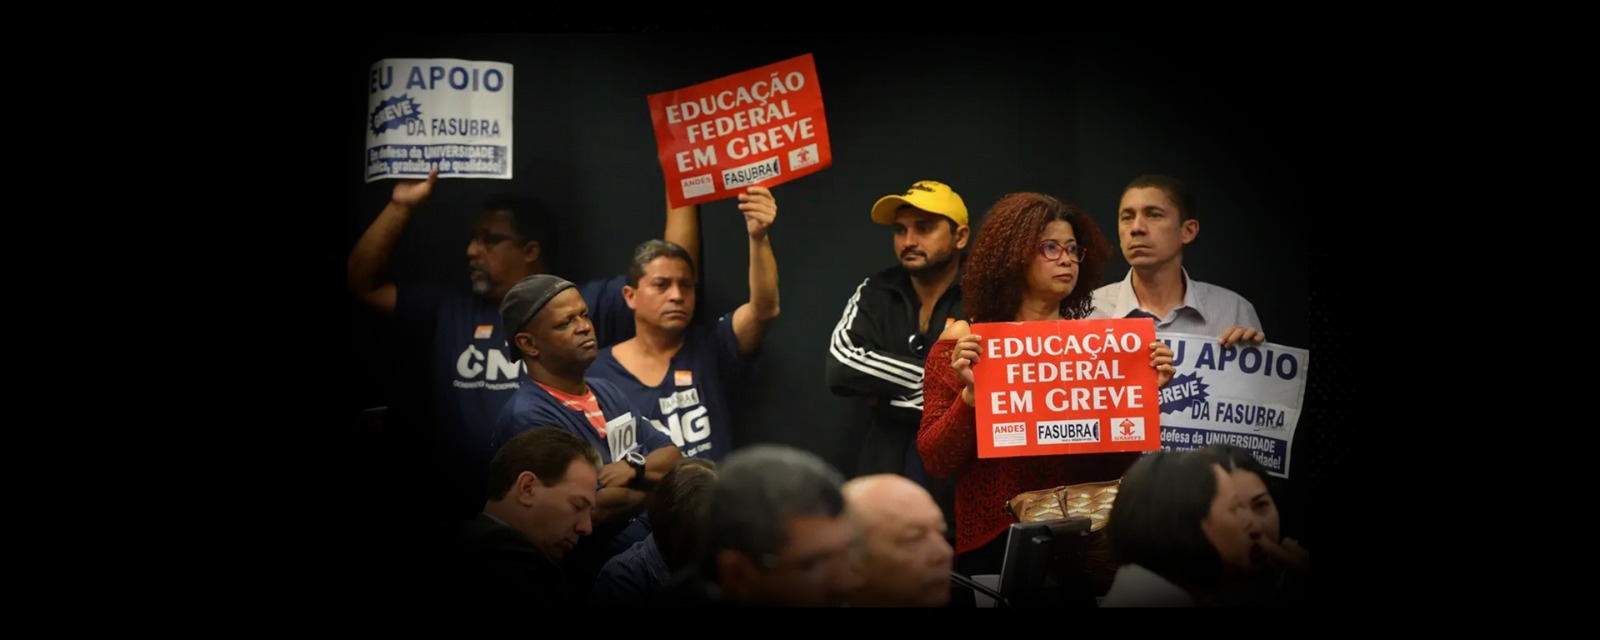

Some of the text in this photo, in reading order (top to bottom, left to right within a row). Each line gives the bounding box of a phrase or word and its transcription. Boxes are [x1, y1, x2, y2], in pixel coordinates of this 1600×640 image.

[370, 66, 504, 94] EU APOIO
[665, 71, 805, 125] EDUCAÇÃO
[373, 100, 414, 130] GREVE
[407, 118, 500, 137] DA FASUBRA
[686, 99, 797, 144] FEDERAL
[410, 146, 422, 159] da
[424, 144, 495, 159] UNIVERSIDADE
[675, 117, 815, 173] EM GREVE
[439, 158, 451, 172] de
[724, 163, 772, 185] FASUBRA
[683, 176, 712, 188] ANDES
[987, 328, 1142, 360] EDUCAÇÃO
[456, 344, 528, 380] CN
[1006, 359, 1126, 384] FEDERAL
[1156, 339, 1298, 381] U APOIO
[991, 385, 1144, 415] EM GREVE
[1191, 399, 1210, 421] DA
[1215, 402, 1285, 428] FASUBRA
[641, 405, 712, 448] NG
[994, 424, 1025, 434] ANDES
[1038, 423, 1092, 440] FASUBRA
[1160, 429, 1190, 443] defesa
[1192, 431, 1204, 444] da
[1205, 431, 1276, 453] UNIVERSIDADE
